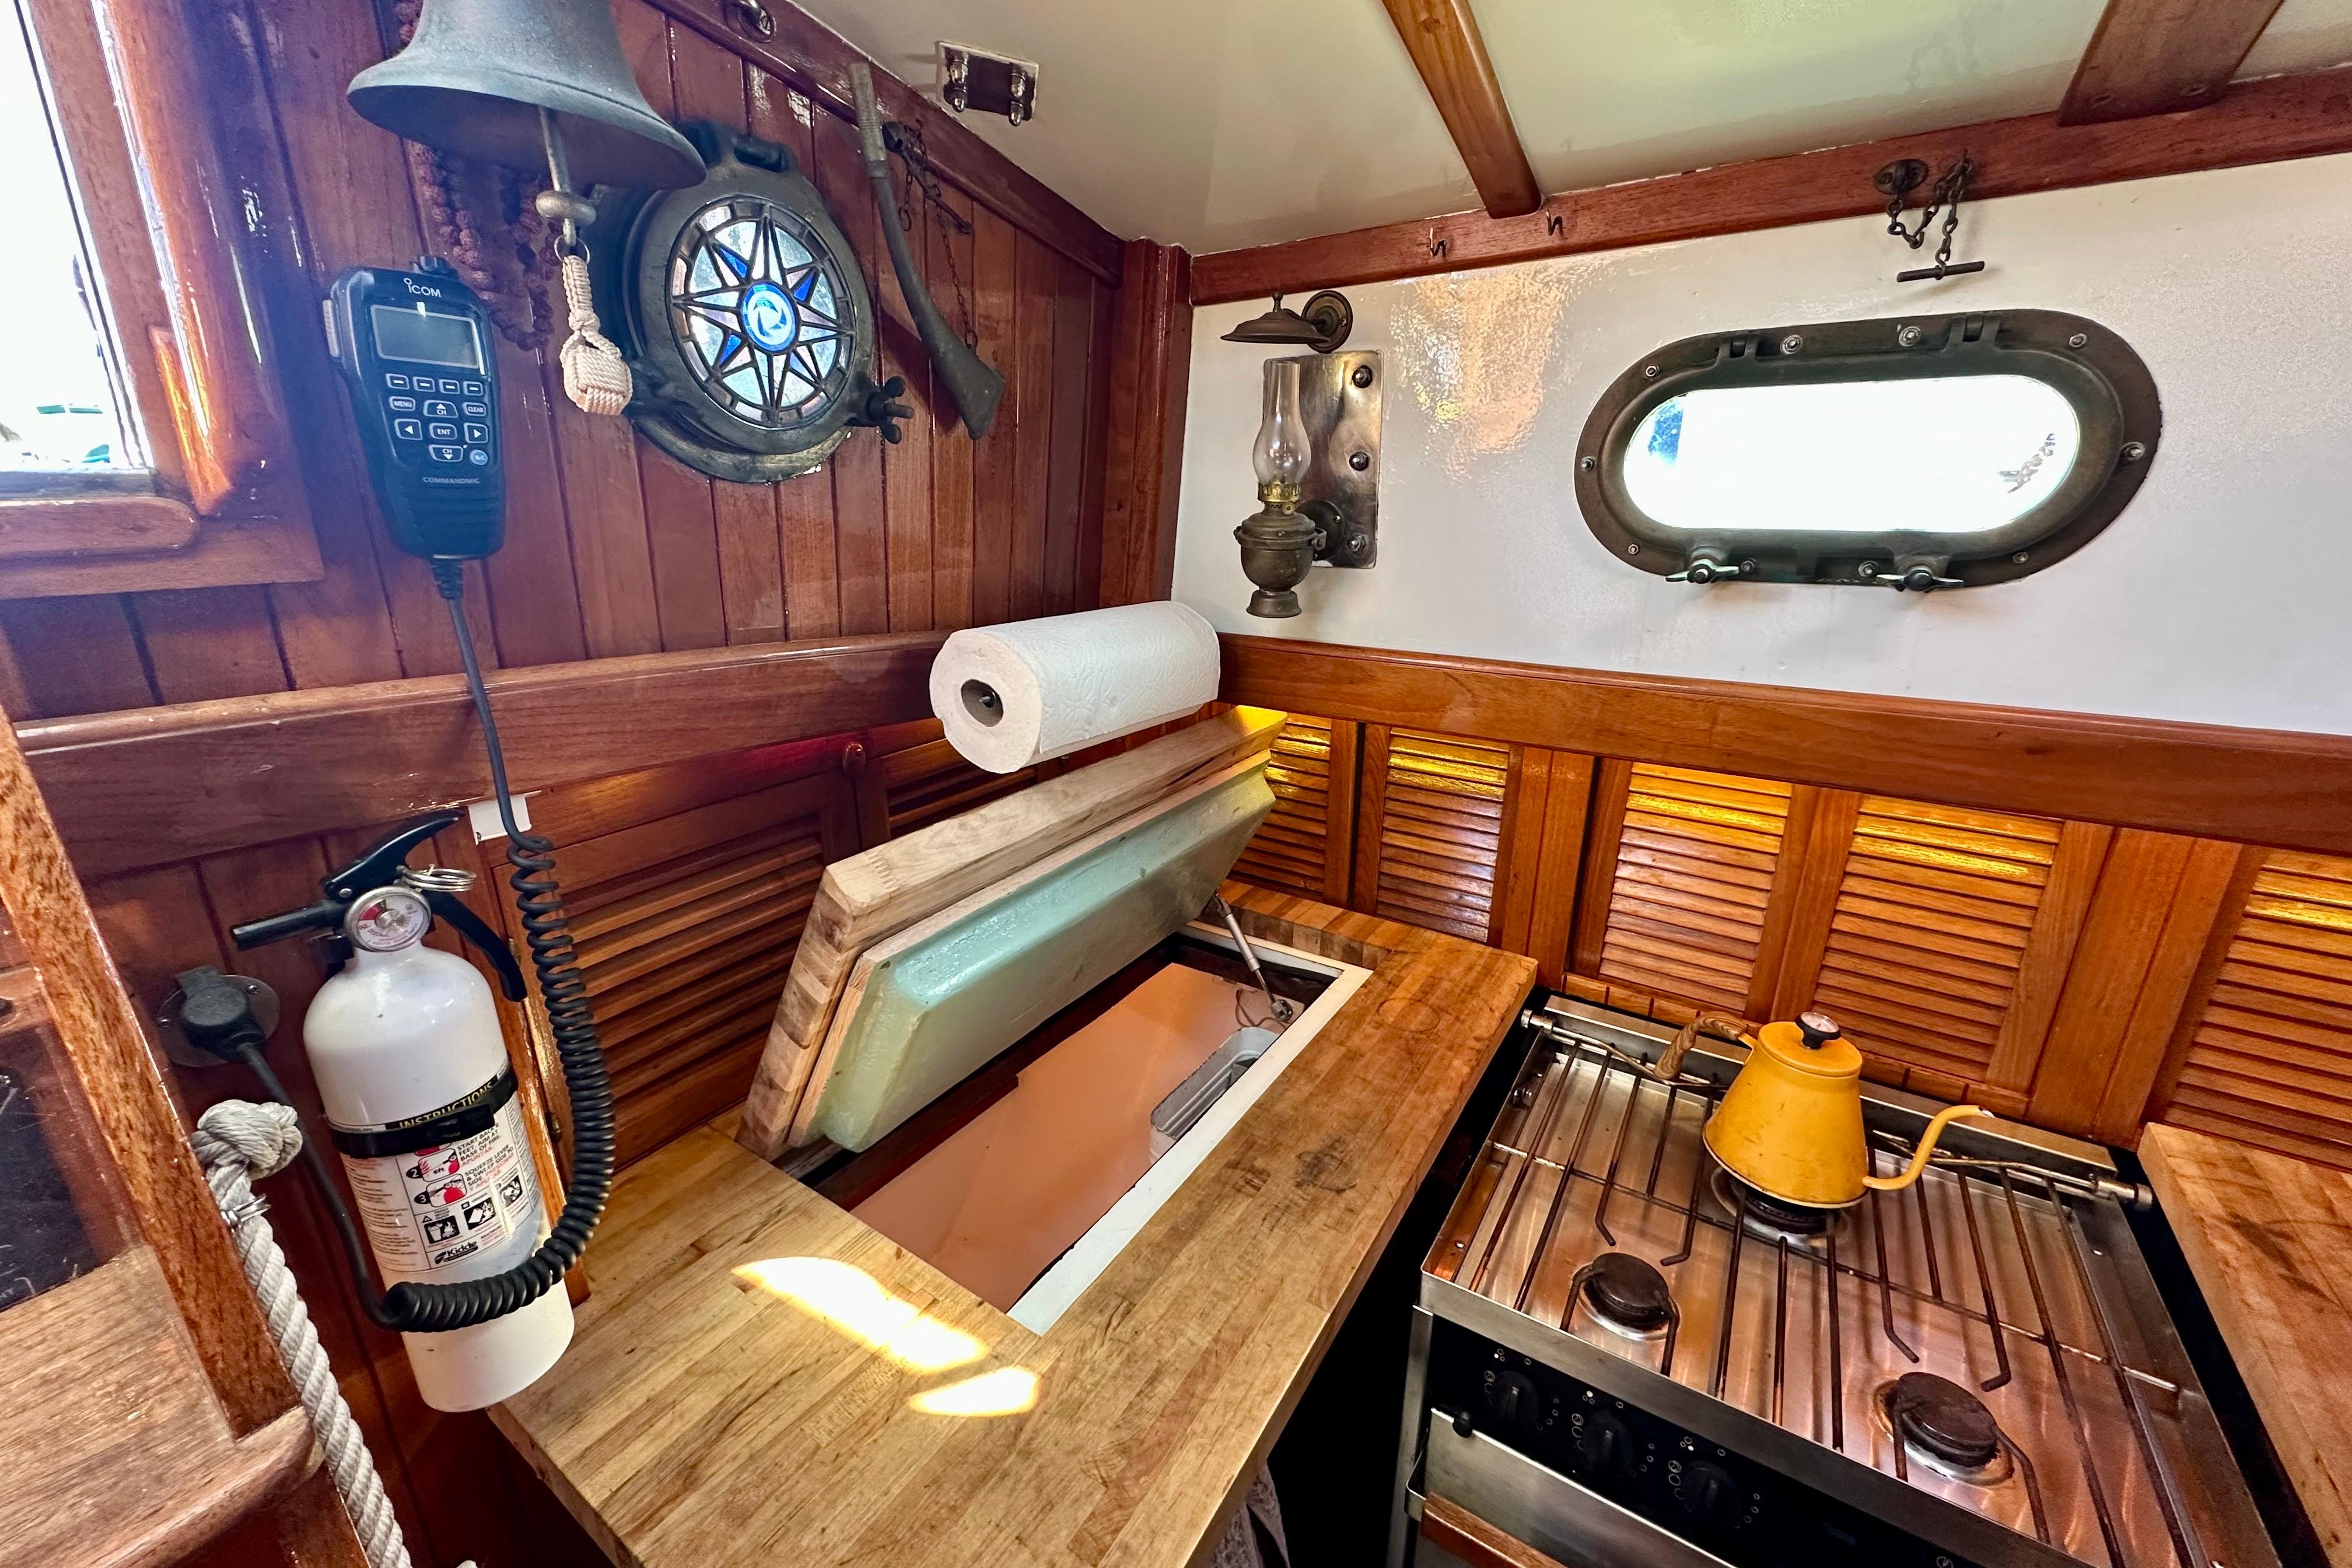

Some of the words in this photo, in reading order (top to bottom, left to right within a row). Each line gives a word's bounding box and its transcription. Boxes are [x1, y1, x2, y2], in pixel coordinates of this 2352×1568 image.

[457, 1136, 478, 1150] START
[478, 1135, 491, 1146] AIM
[491, 1129, 498, 1137] AT
[460, 1150, 478, 1161] BASE
[494, 1144, 509, 1159] LEVER
[495, 1153, 507, 1164] SIDE
[410, 1169, 419, 1178] 2
[419, 1195, 426, 1203] 3
[447, 1241, 477, 1256] Kidde
